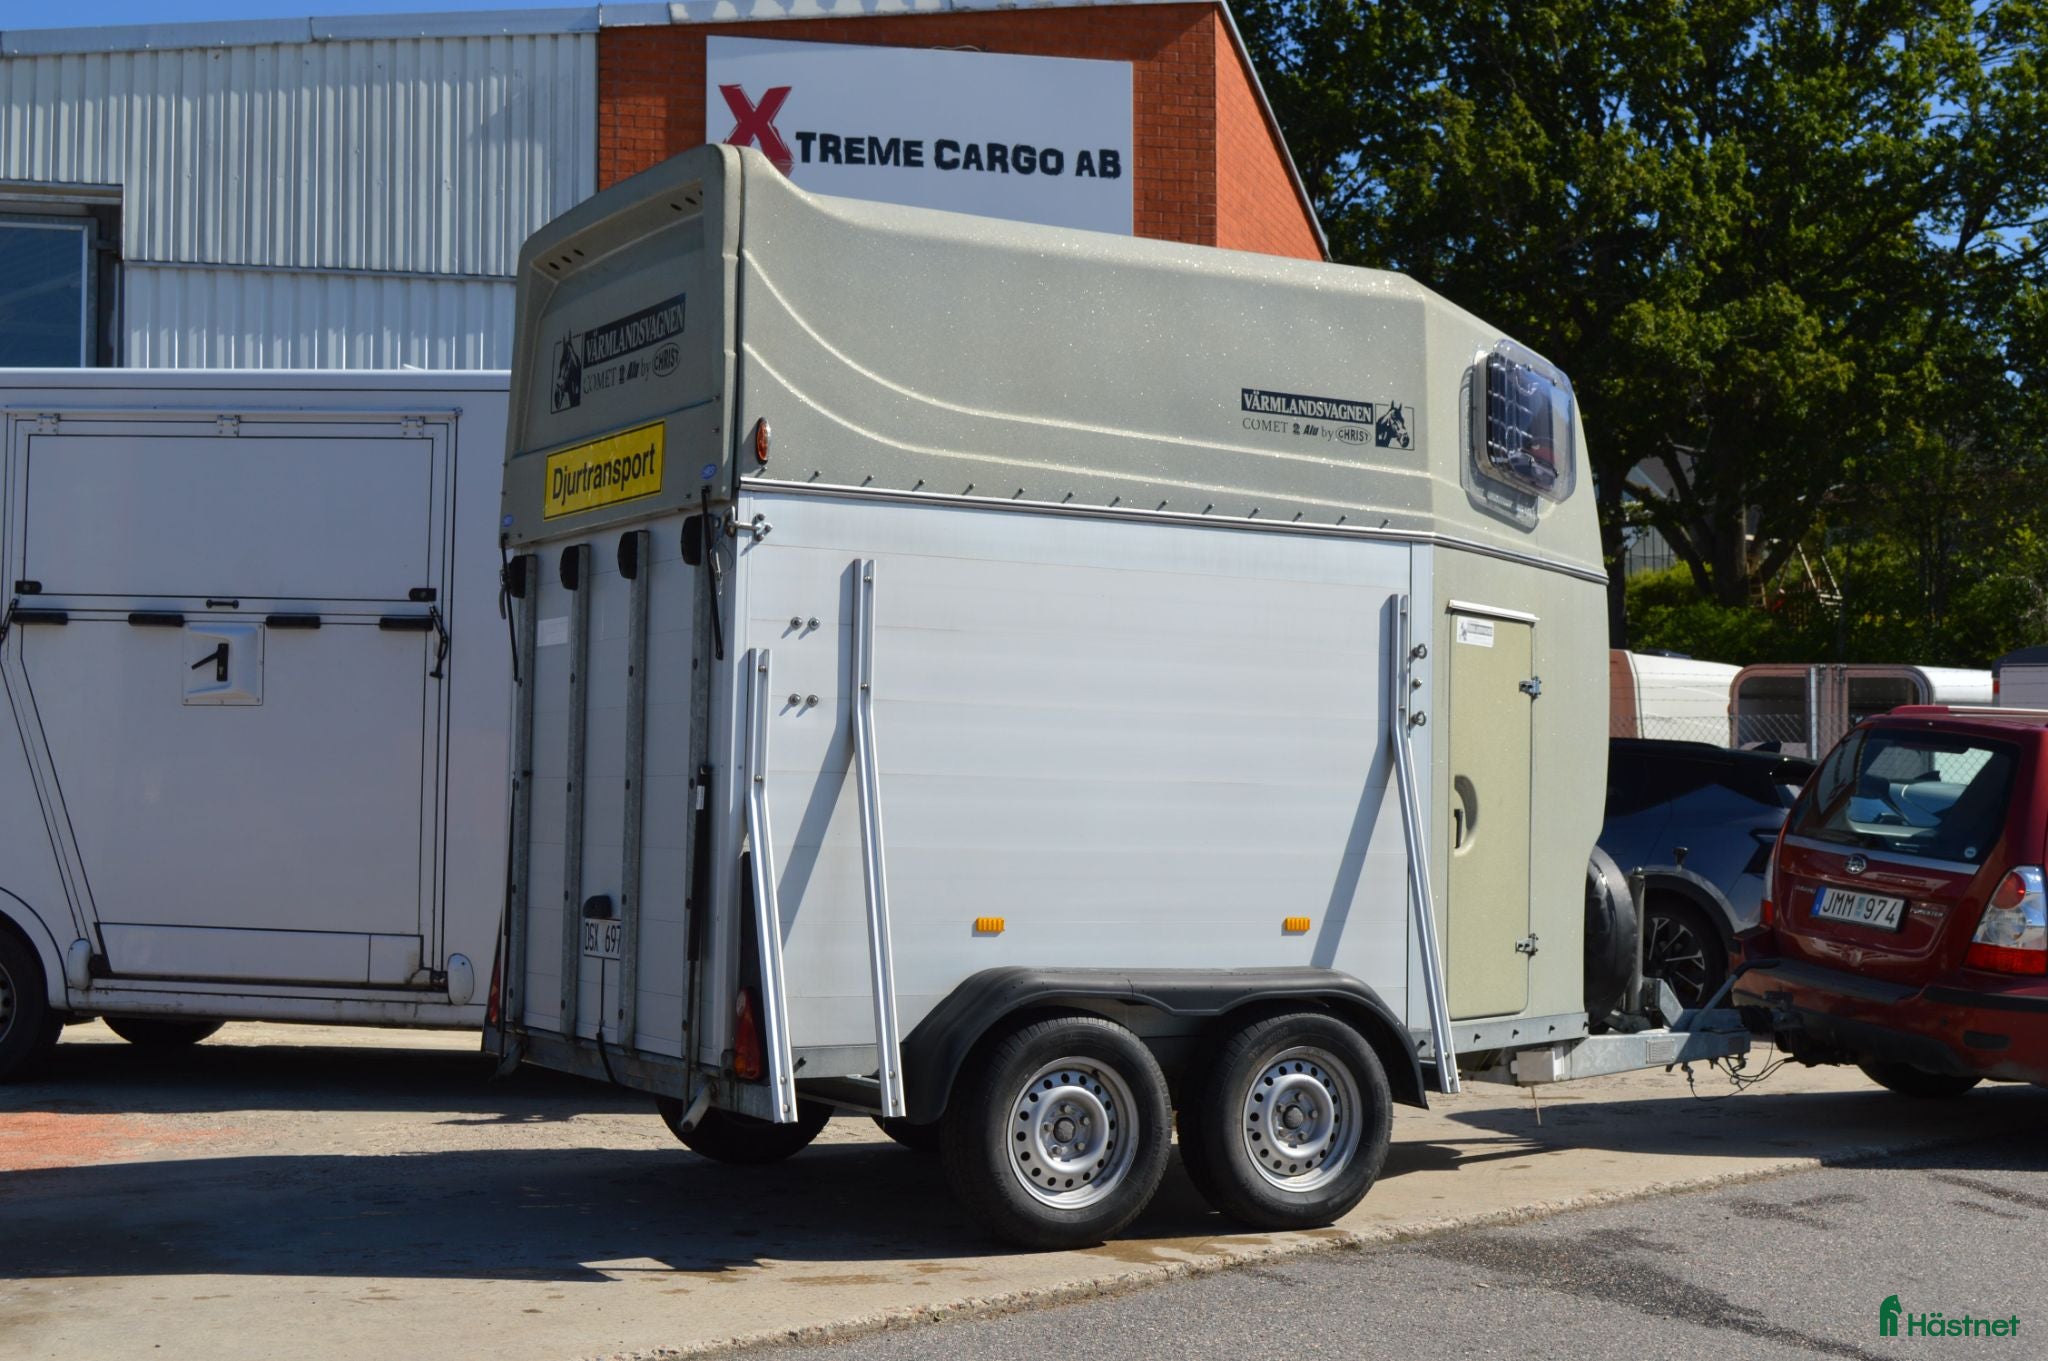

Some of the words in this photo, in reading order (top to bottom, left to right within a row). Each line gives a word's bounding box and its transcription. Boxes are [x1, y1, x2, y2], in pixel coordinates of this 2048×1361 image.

[934, 138, 1065, 177] CARGO
[1075, 149, 1122, 179] AB
[585, 303, 685, 363] VÄRMLANDSVAGNEN
[583, 366, 617, 394] COMET
[640, 356, 651, 381] by
[653, 348, 680, 371] CHRIST
[1243, 390, 1373, 423] VÄRMLANDSVAGNEN
[1242, 417, 1289, 434] COMET
[1321, 426, 1335, 442] by
[1338, 429, 1370, 442] CHRIST
[552, 443, 656, 506] Djurtransport
[1822, 891, 1856, 917] JMM
[1863, 897, 1898, 925] 974
[604, 924, 622, 955] 697
